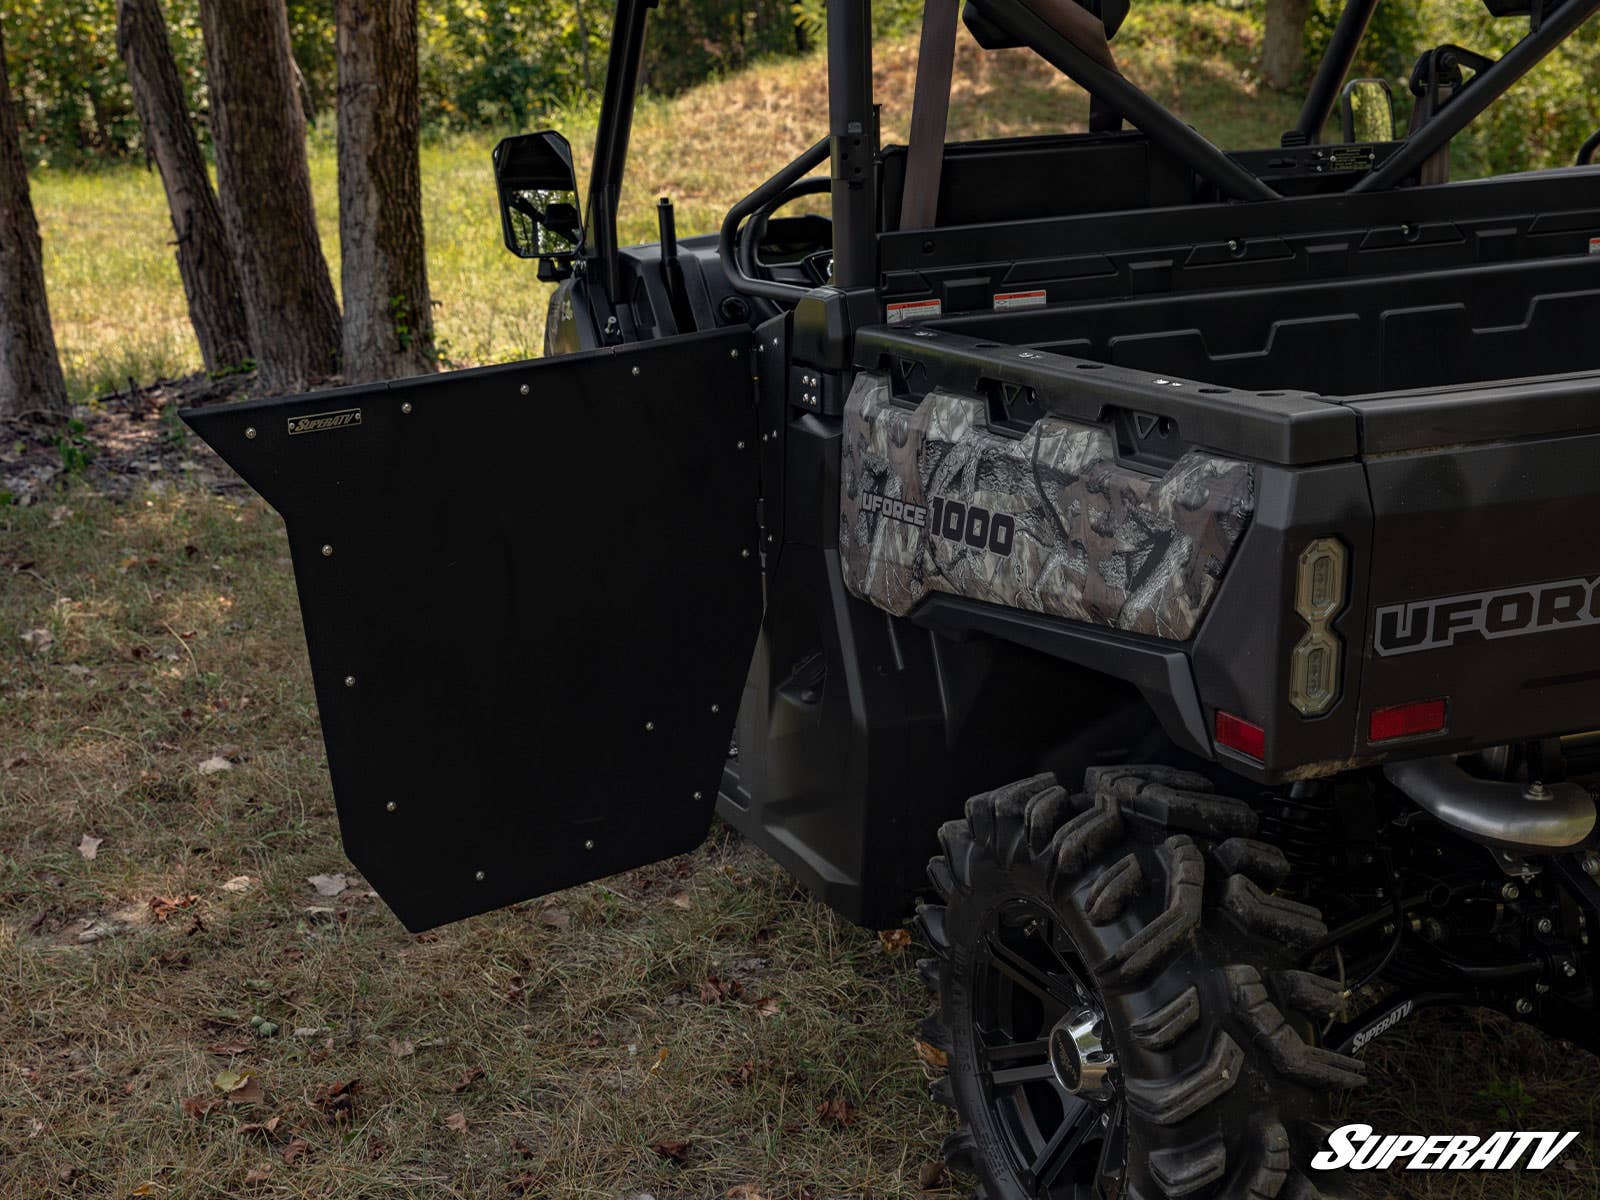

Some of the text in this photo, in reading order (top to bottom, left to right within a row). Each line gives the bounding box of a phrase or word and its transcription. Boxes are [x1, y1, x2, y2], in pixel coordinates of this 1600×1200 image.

[294, 413, 355, 432] SUPERATV
[861, 492, 1016, 557] UFORCE 1000
[1374, 577, 1600, 657] UFOR
[1351, 1000, 1414, 1053] SUPERATV
